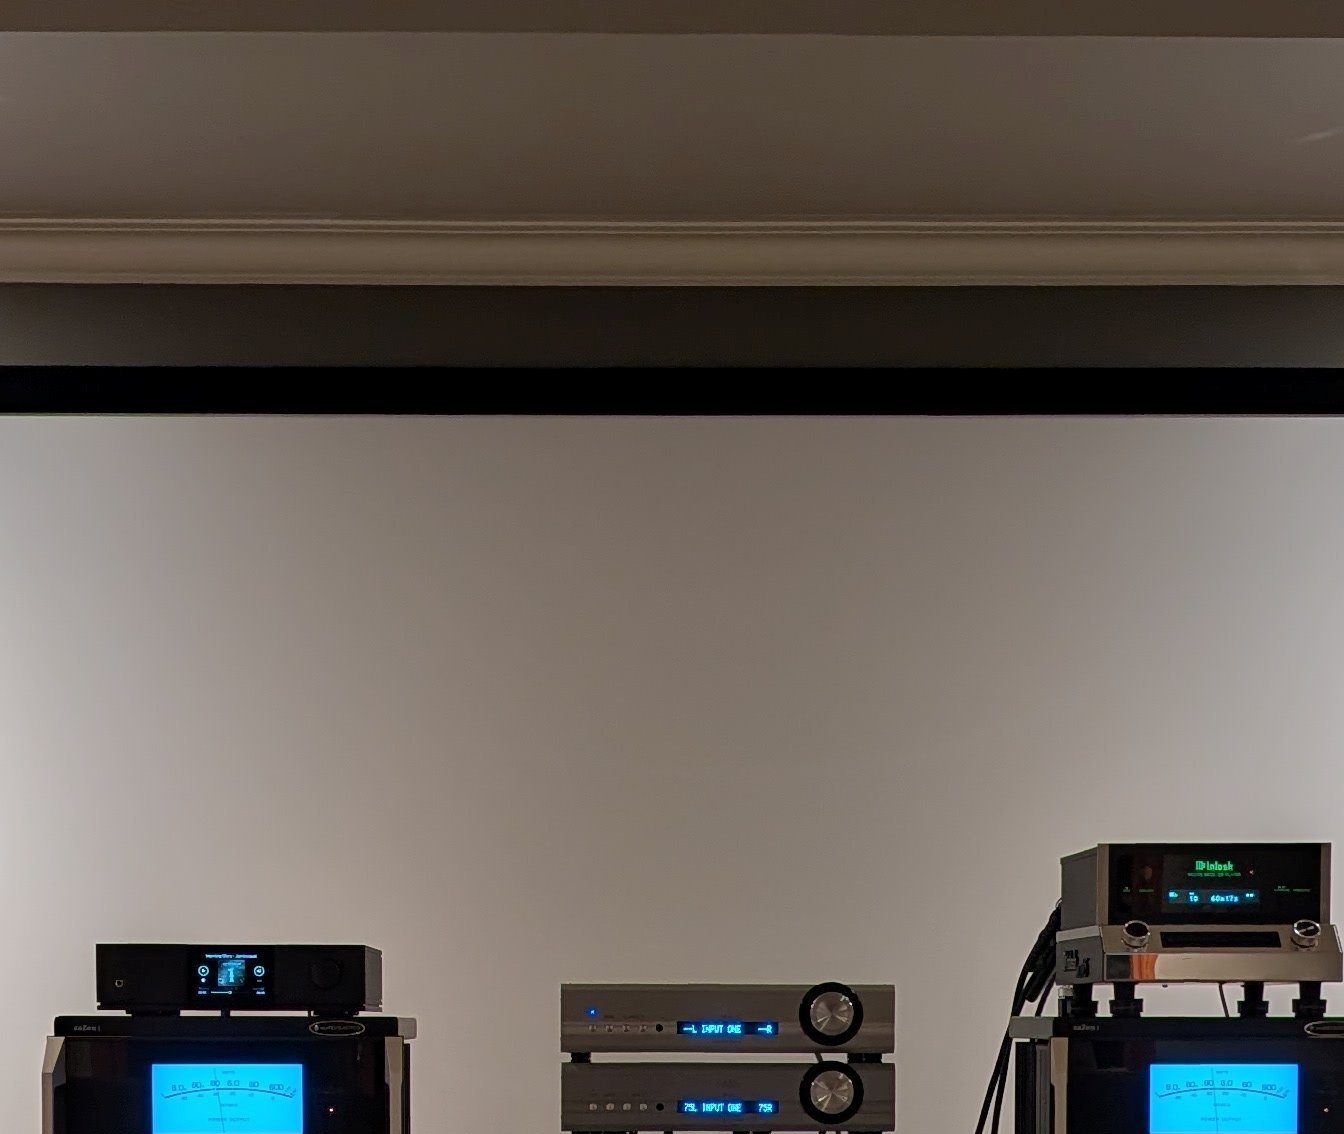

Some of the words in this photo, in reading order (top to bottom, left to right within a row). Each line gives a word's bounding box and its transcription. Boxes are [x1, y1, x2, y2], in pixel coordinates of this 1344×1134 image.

[1195, 861, 1234, 871] McIntosh
[702, 1024, 724, 1034] INPUT
[727, 1024, 742, 1034] ONE
[702, 1103, 724, 1112] INPUT
[727, 1103, 742, 1112] ONE
